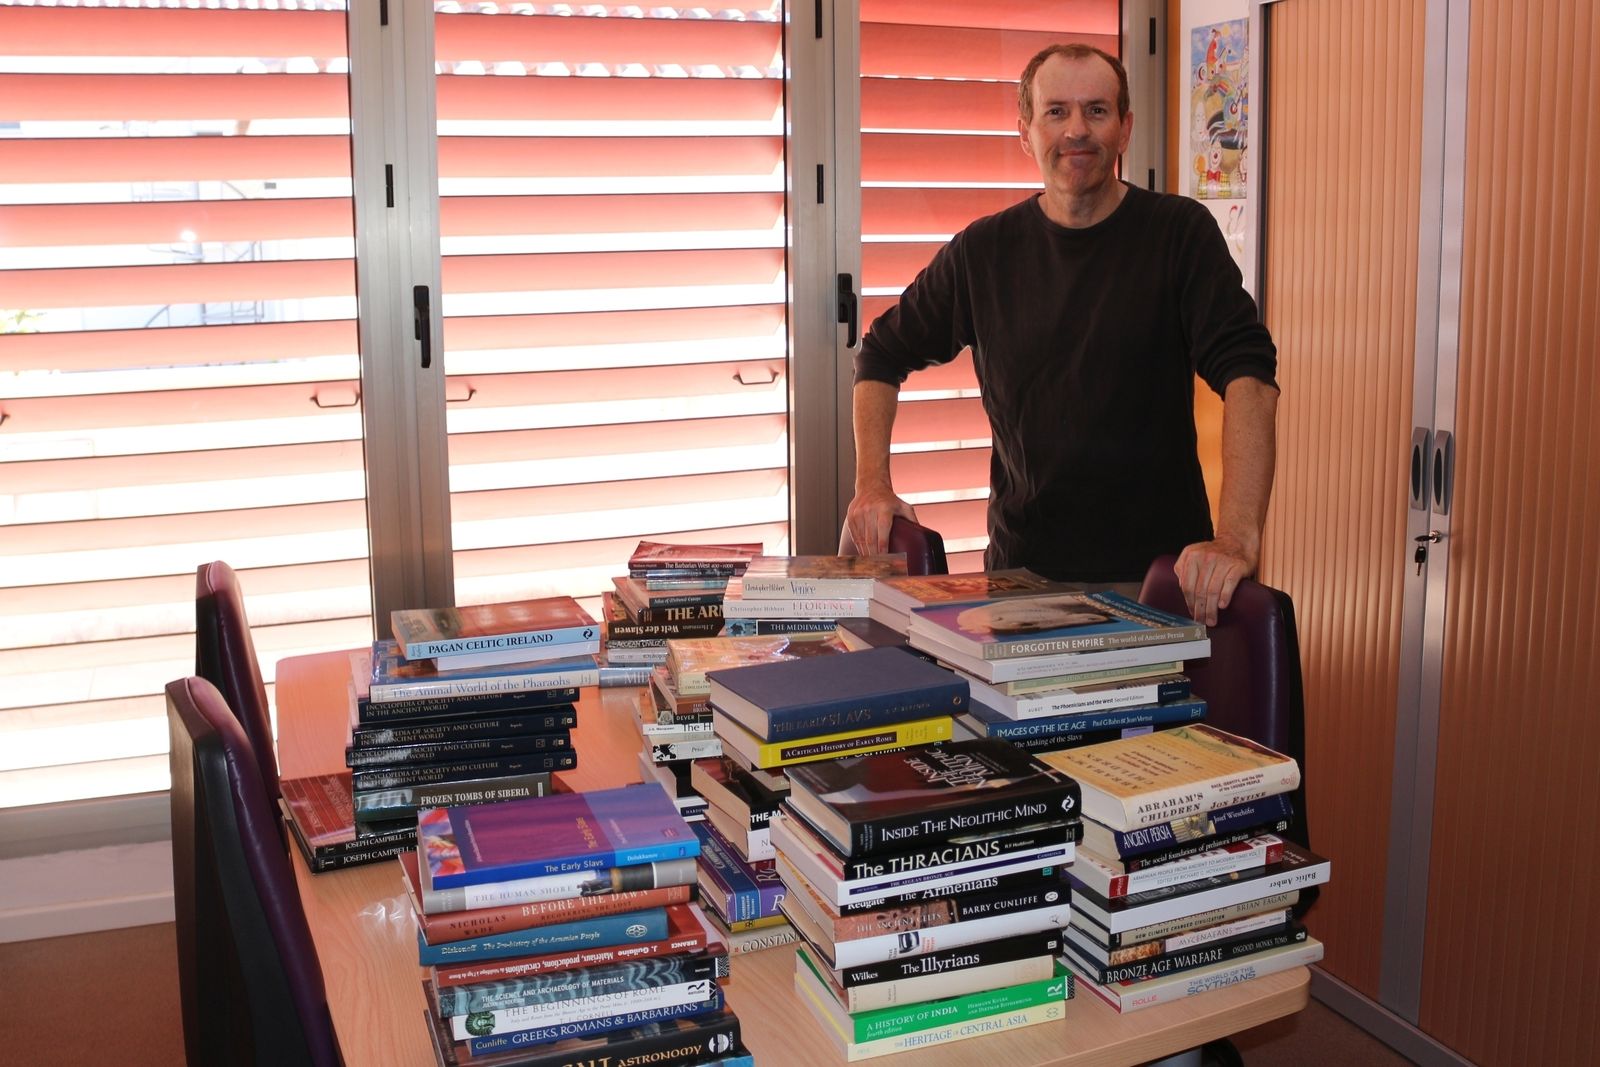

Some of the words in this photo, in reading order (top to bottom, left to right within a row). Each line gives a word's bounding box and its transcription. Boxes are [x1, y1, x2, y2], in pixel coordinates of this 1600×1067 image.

[790, 581, 816, 595] Venice
[665, 607, 695, 621] THE
[792, 601, 854, 611] FLORENCE
[614, 625, 644, 635] Slawen
[645, 625, 659, 634] der
[660, 625, 679, 634] Welt
[786, 623, 820, 631] MEDIEVAL
[428, 642, 464, 655] PAGAN
[466, 638, 504, 651] CELTIC
[506, 634, 553, 647] IRELAND
[1011, 640, 1069, 654] FORGOTTEN
[1072, 637, 1104, 648] EMPIRE
[1120, 636, 1136, 644] world
[1145, 633, 1166, 642] Ancient
[1167, 632, 1184, 640] Persia
[391, 687, 410, 697] The
[414, 684, 452, 696] Animal
[455, 682, 488, 693] World
[491, 681, 502, 690] of
[504, 679, 519, 689] the
[523, 676, 571, 688] Pharaohs
[423, 726, 450, 734] SOCIETY
[469, 722, 499, 730] CULTURE
[683, 724, 700, 732] The
[997, 726, 1027, 737] IMAGES
[1029, 724, 1040, 734] OF
[1041, 723, 1056, 733] THE
[1057, 722, 1069, 731] ICE
[1070, 720, 1086, 730] AGE
[791, 746, 819, 756] CRITICAL
[820, 742, 846, 752] HISTORY
[855, 738, 874, 748] EARLY
[875, 735, 892, 745] ROME
[1014, 740, 1024, 749] The
[1024, 737, 1048, 750] Making
[1049, 737, 1055, 745] of
[1056, 735, 1065, 744] the
[1066, 733, 1082, 743] Slavs
[423, 767, 450, 775] SOCIETY
[469, 763, 498, 771] CULTURE
[420, 794, 452, 806] FROZEN
[454, 791, 482, 803] TOMBS
[485, 790, 495, 800] OF
[497, 788, 529, 799] SIBERIA
[1137, 792, 1204, 814] ABRAHAM'S
[1210, 800, 1228, 810] JON
[1231, 791, 1266, 805] ENTINE
[751, 812, 769, 823] THE
[1141, 802, 1201, 824] CHILDREN
[882, 824, 919, 841] INSIDE
[921, 820, 947, 834] THE
[950, 808, 1012, 829] NEOLITHIC
[1015, 803, 1047, 818] MIND
[345, 840, 369, 850] JOSEPH
[1123, 828, 1150, 849] ANCIENT
[1150, 824, 1172, 845] PERSIA
[343, 852, 371, 864] JOSEPH
[1140, 857, 1150, 868] The
[1152, 853, 1167, 865] social
[1168, 846, 1197, 861] foundations
[1199, 844, 1205, 853] of
[1206, 838, 1229, 852] prehistoric
[1231, 834, 1248, 845] Britain
[544, 865, 558, 873] The
[561, 862, 581, 872] Early
[584, 859, 604, 869] Slavs
[853, 863, 884, 879] The
[889, 841, 1000, 873] THRACIANS
[1270, 877, 1293, 888] Amber
[1295, 872, 1316, 882] Baltic
[474, 894, 494, 903] THE
[500, 889, 537, 900] HUMAN
[541, 885, 573, 896] SHORE
[900, 892, 917, 901] The
[922, 876, 998, 899] Armenians
[522, 898, 573, 916] BEFORE
[578, 895, 606, 907] THE
[611, 891, 648, 902] DAWN
[963, 903, 991, 915] BARRY
[994, 896, 1038, 910] CUNLIFFE
[1236, 901, 1260, 912] BRIAN
[1263, 894, 1288, 906] FAGAN
[450, 914, 507, 929] NICHOLAS
[857, 922, 873, 933] THE
[877, 916, 914, 930] ANCIENT
[1135, 931, 1146, 939] HOW
[1147, 926, 1169, 937] CLIMATE
[1170, 921, 1193, 932] CHANGED
[1194, 914, 1225, 927] CIVILIZATION
[464, 926, 494, 935] WADE
[531, 937, 538, 947] of
[539, 936, 548, 945] the
[580, 932, 600, 943] People
[671, 939, 697, 949] ERRANCE
[618, 946, 651, 957] Guilaine
[505, 961, 541, 974] circulations
[851, 971, 878, 982] Wilkes
[901, 963, 920, 975] The
[920, 953, 980, 973] Illyrians
[1106, 964, 1148, 984] BRONZE
[1151, 960, 1171, 974] AGE
[1174, 949, 1223, 969] WARFARE
[1187, 971, 1256, 996] SCYTHIANS
[1204, 973, 1228, 984] WORLD
[482, 993, 494, 1002] THE
[523, 988, 536, 997] AND
[538, 982, 580, 995] ARCHAEOLOGY
[582, 981, 589, 989] OF
[592, 976, 624, 988] MATERIALS
[504, 1004, 528, 1017] THE
[533, 993, 611, 1013] BEGINNINGS
[614, 991, 628, 1002] OF
[633, 986, 666, 999] ROME
[1132, 995, 1157, 1006] ROLLE
[875, 1014, 914, 1029] HISTORY
[917, 1011, 929, 1020] OF
[931, 1006, 958, 1018] INDIA
[476, 1038, 507, 1050] Cunliffe
[512, 1028, 559, 1045] GREEKS,
[560, 1020, 612, 1035] ROMANS
[614, 1016, 624, 1026] &
[627, 1003, 697, 1023] BARBARIANS
[866, 1030, 884, 1040] fourth
[884, 1026, 902, 1036] edition
[904, 1028, 952, 1047] HERITAGE
[960, 1020, 1004, 1036] CENTRAL
[1006, 1014, 1028, 1026] ASIA
[618, 1045, 702, 1067] ASTRONOMY
